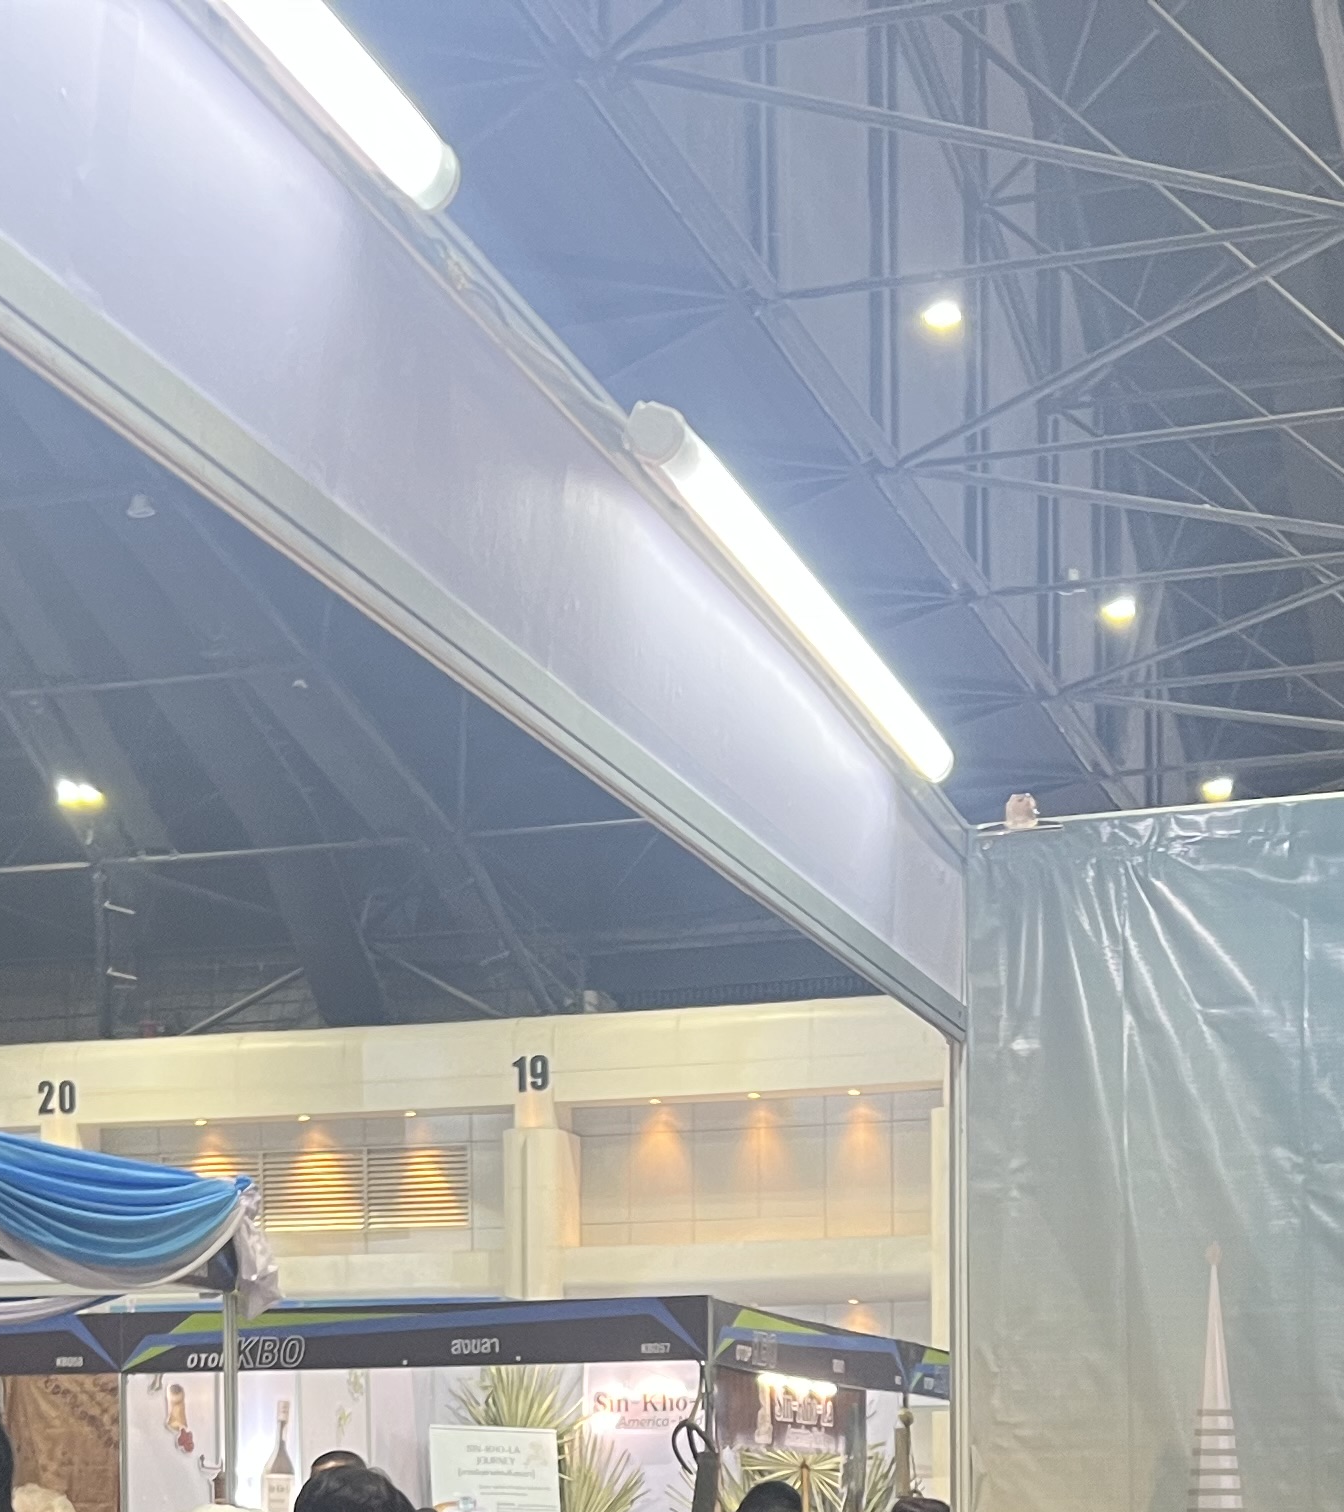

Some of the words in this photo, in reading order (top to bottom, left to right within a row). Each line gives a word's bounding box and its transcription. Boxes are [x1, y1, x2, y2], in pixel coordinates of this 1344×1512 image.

[512, 1054, 551, 1093] 19
[37, 1079, 77, 1115] 20
[186, 1351, 225, 1369] OTO
[236, 1335, 306, 1369] KBO
[450, 1337, 501, 1355] สงขลา
